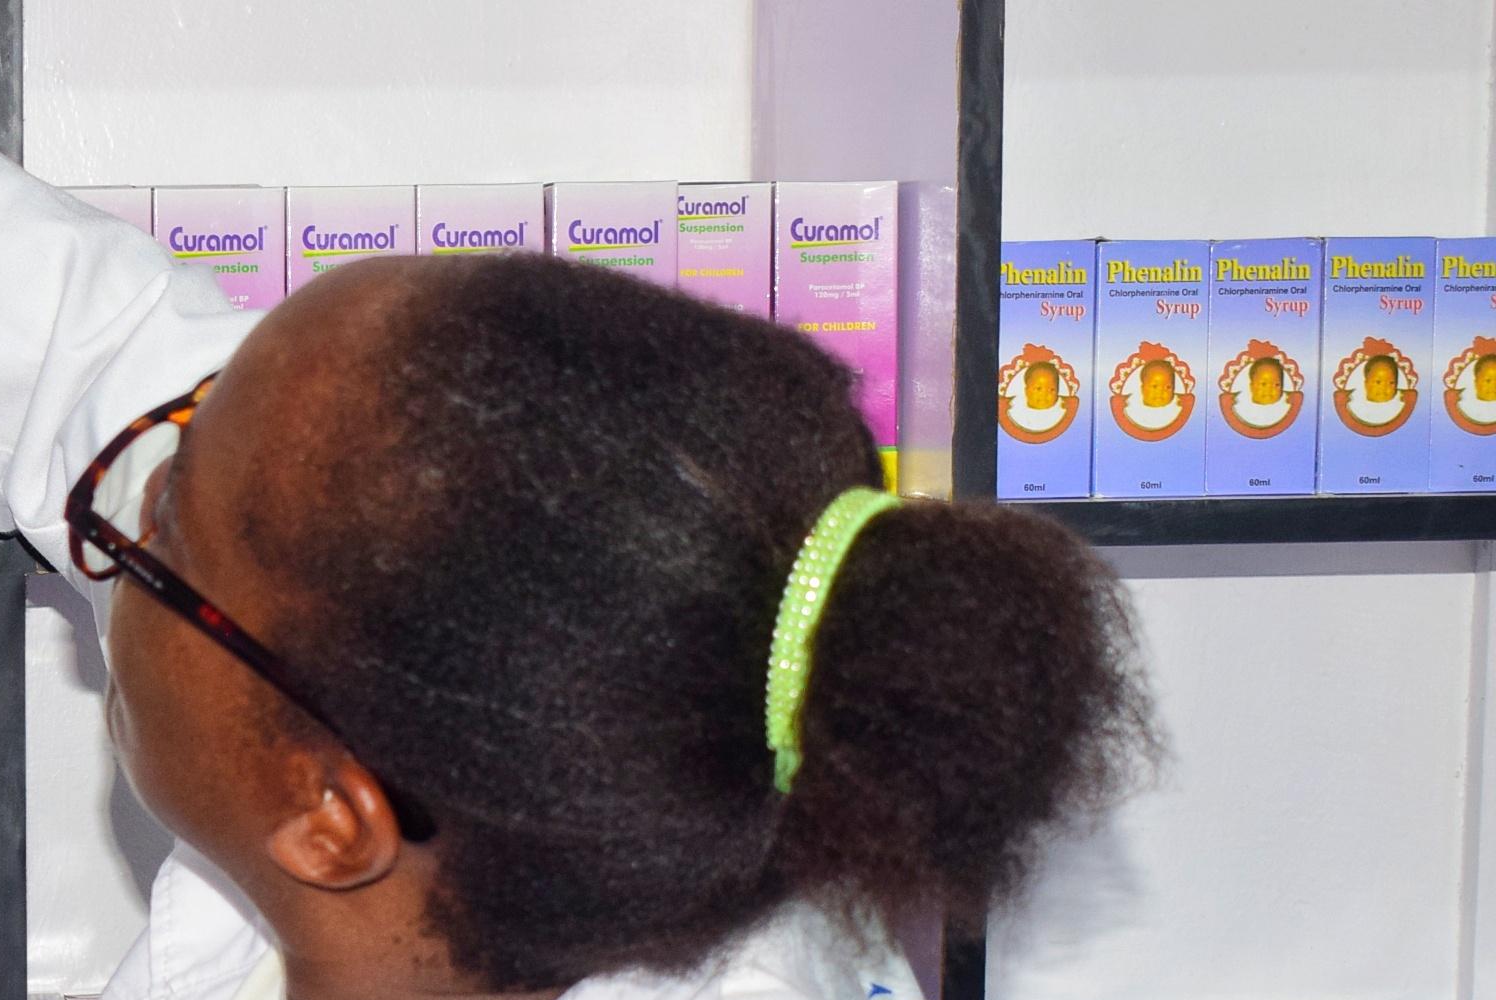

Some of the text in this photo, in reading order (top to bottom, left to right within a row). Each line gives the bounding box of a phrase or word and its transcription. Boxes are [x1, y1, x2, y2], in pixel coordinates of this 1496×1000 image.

[303, 225, 394, 250] Curamol
[432, 223, 524, 247] Curamol
[569, 220, 658, 244] Curamol
[679, 223, 744, 234] Suspension
[791, 217, 879, 241] Curamol
[170, 227, 263, 251] Curamol
[800, 252, 873, 264] Suspension
[1330, 255, 1425, 279] Phenalin
[680, 269, 744, 277] FOR CHILDREN
[1106, 260, 1202, 284] Phenalin
[1215, 258, 1310, 282] Phenalin
[1109, 287, 1199, 297] Chlorpheniramine Oral
[1333, 285, 1403, 293] Chlorpheniramine
[1040, 301, 1085, 320] Syrup
[1156, 299, 1200, 320] Syrup
[1265, 297, 1308, 319] Syrup
[1379, 295, 1423, 315] Syrup
[822, 322, 876, 331] CHILDREN
[1024, 483, 1045, 493] 60ml
[1140, 481, 1162, 490] 60ml
[1249, 478, 1271, 488] 60ml
[1359, 476, 1381, 485] 60ml
